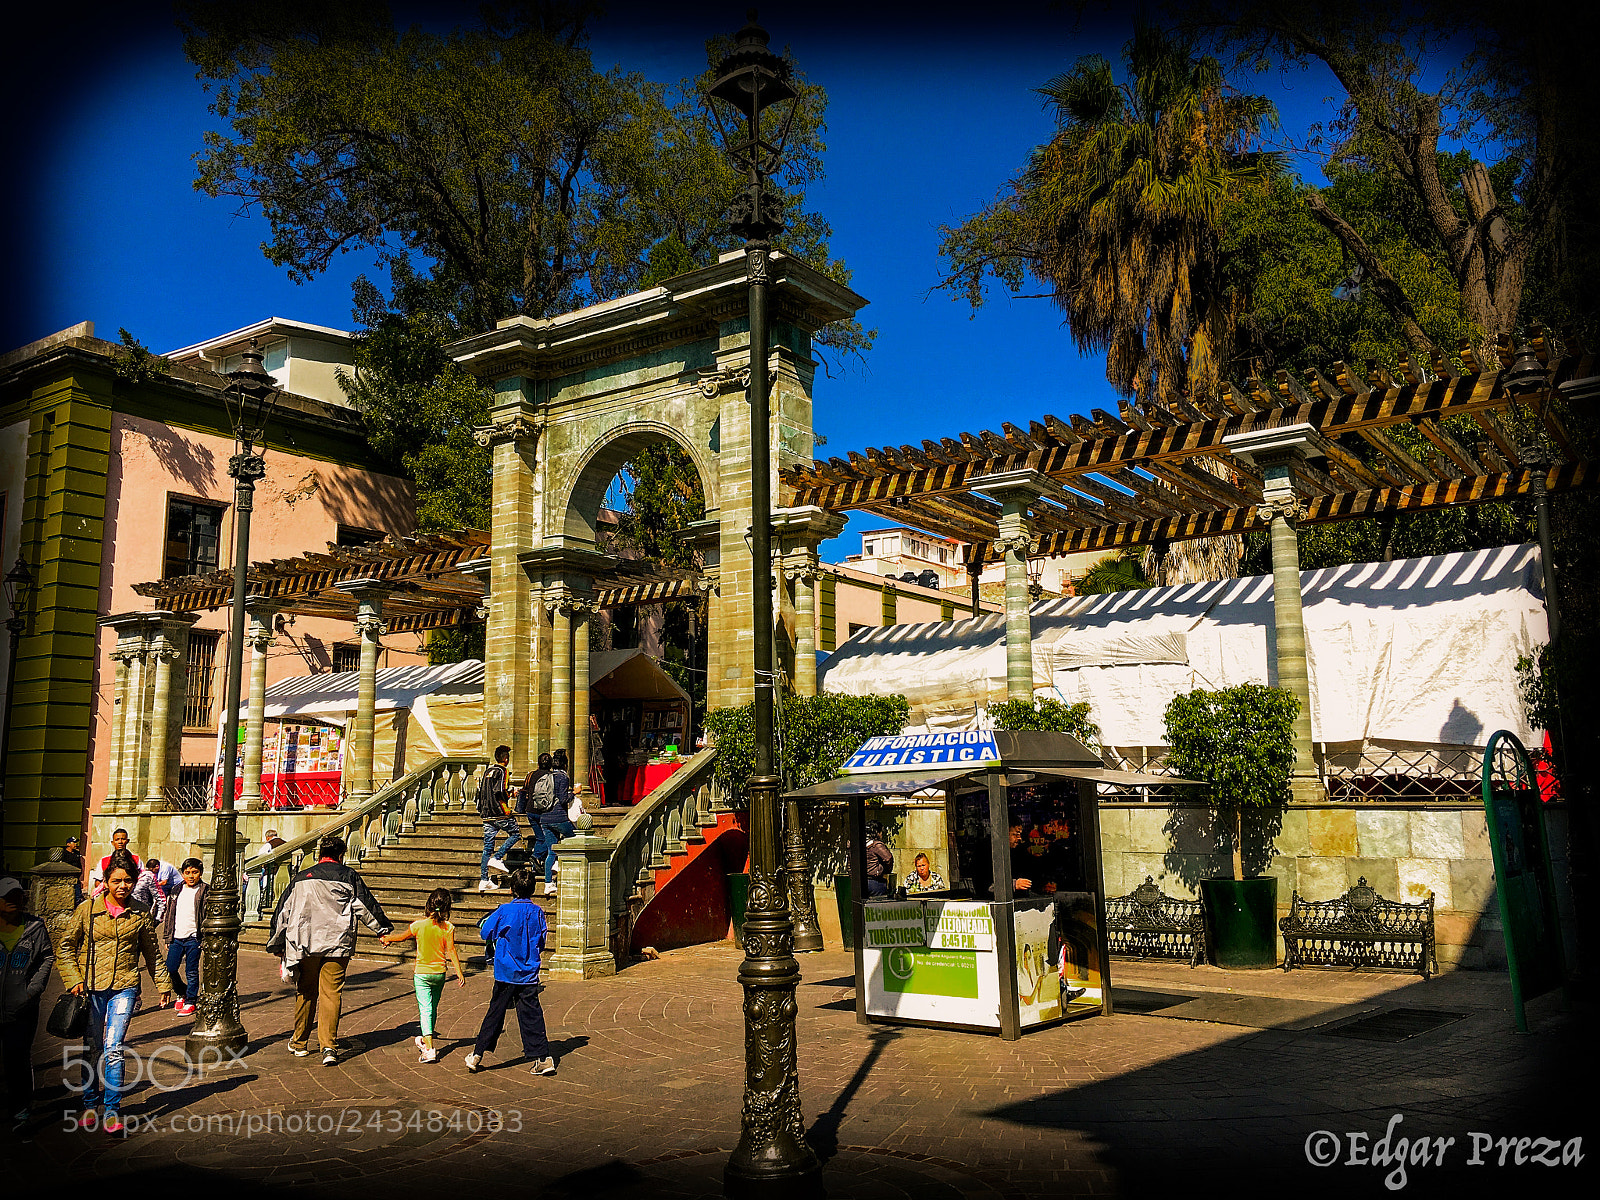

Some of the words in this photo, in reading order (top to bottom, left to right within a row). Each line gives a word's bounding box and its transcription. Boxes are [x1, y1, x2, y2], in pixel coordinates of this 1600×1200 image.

[848, 747, 996, 767] TURÍSTICA
[927, 917, 989, 933] CALLEJONEADA
[868, 926, 924, 945] TURÍSTICOS
[941, 934, 959, 948] 8:45
[961, 935, 977, 948] P.M.
